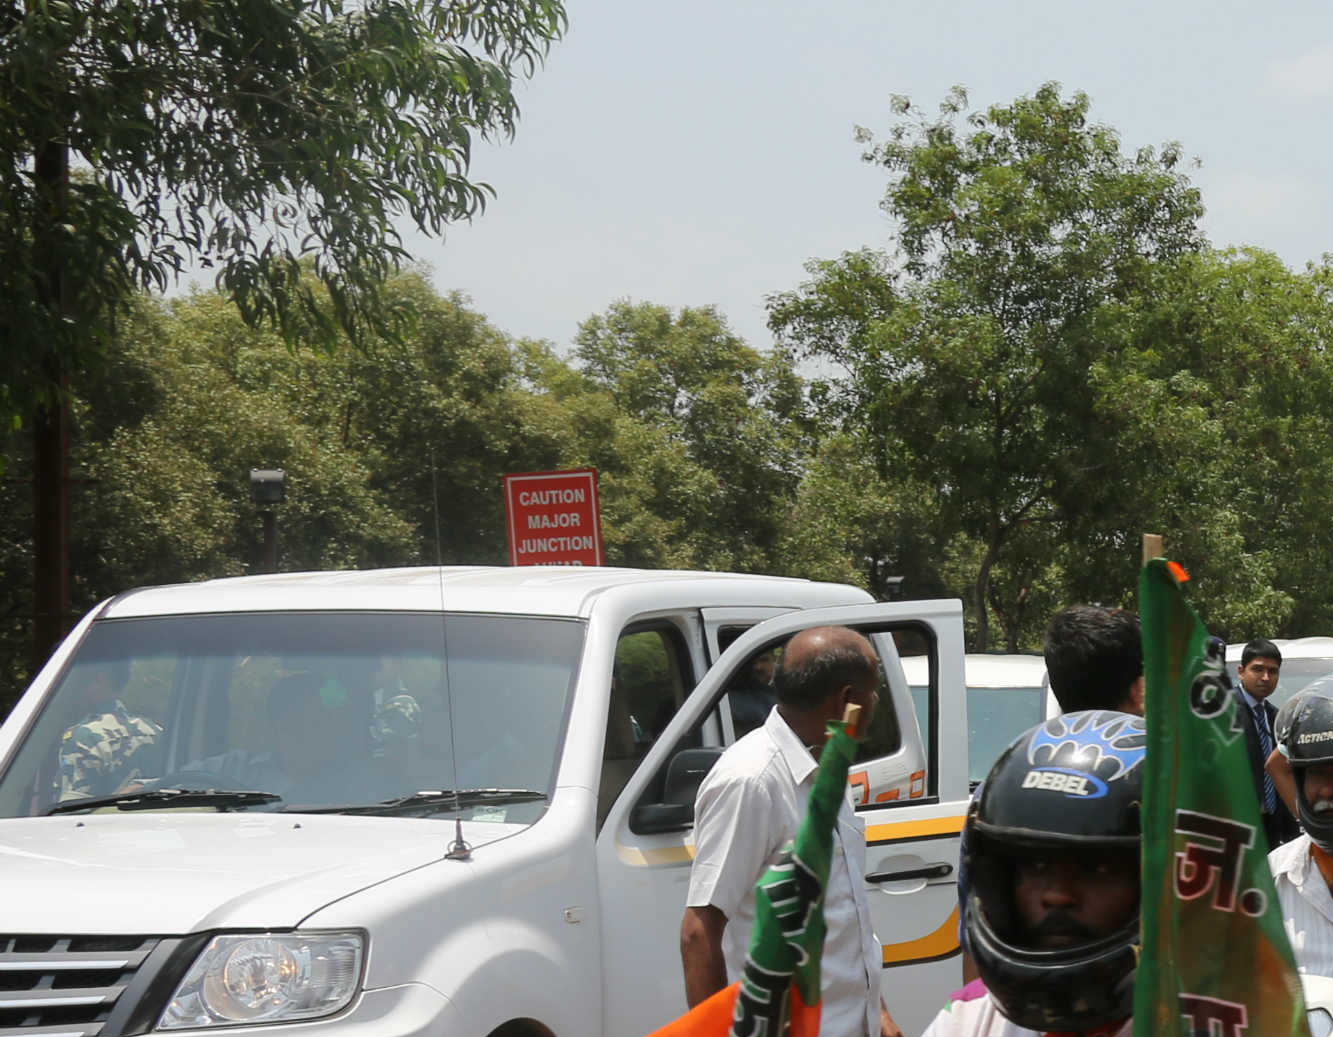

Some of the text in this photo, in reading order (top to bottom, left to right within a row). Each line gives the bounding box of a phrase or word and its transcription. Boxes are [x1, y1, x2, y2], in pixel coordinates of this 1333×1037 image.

[519, 488, 585, 506] CAUTION
[527, 512, 581, 529] MAJOR
[518, 536, 594, 554] JUNCTION
[1021, 771, 1088, 796] DEBEL
